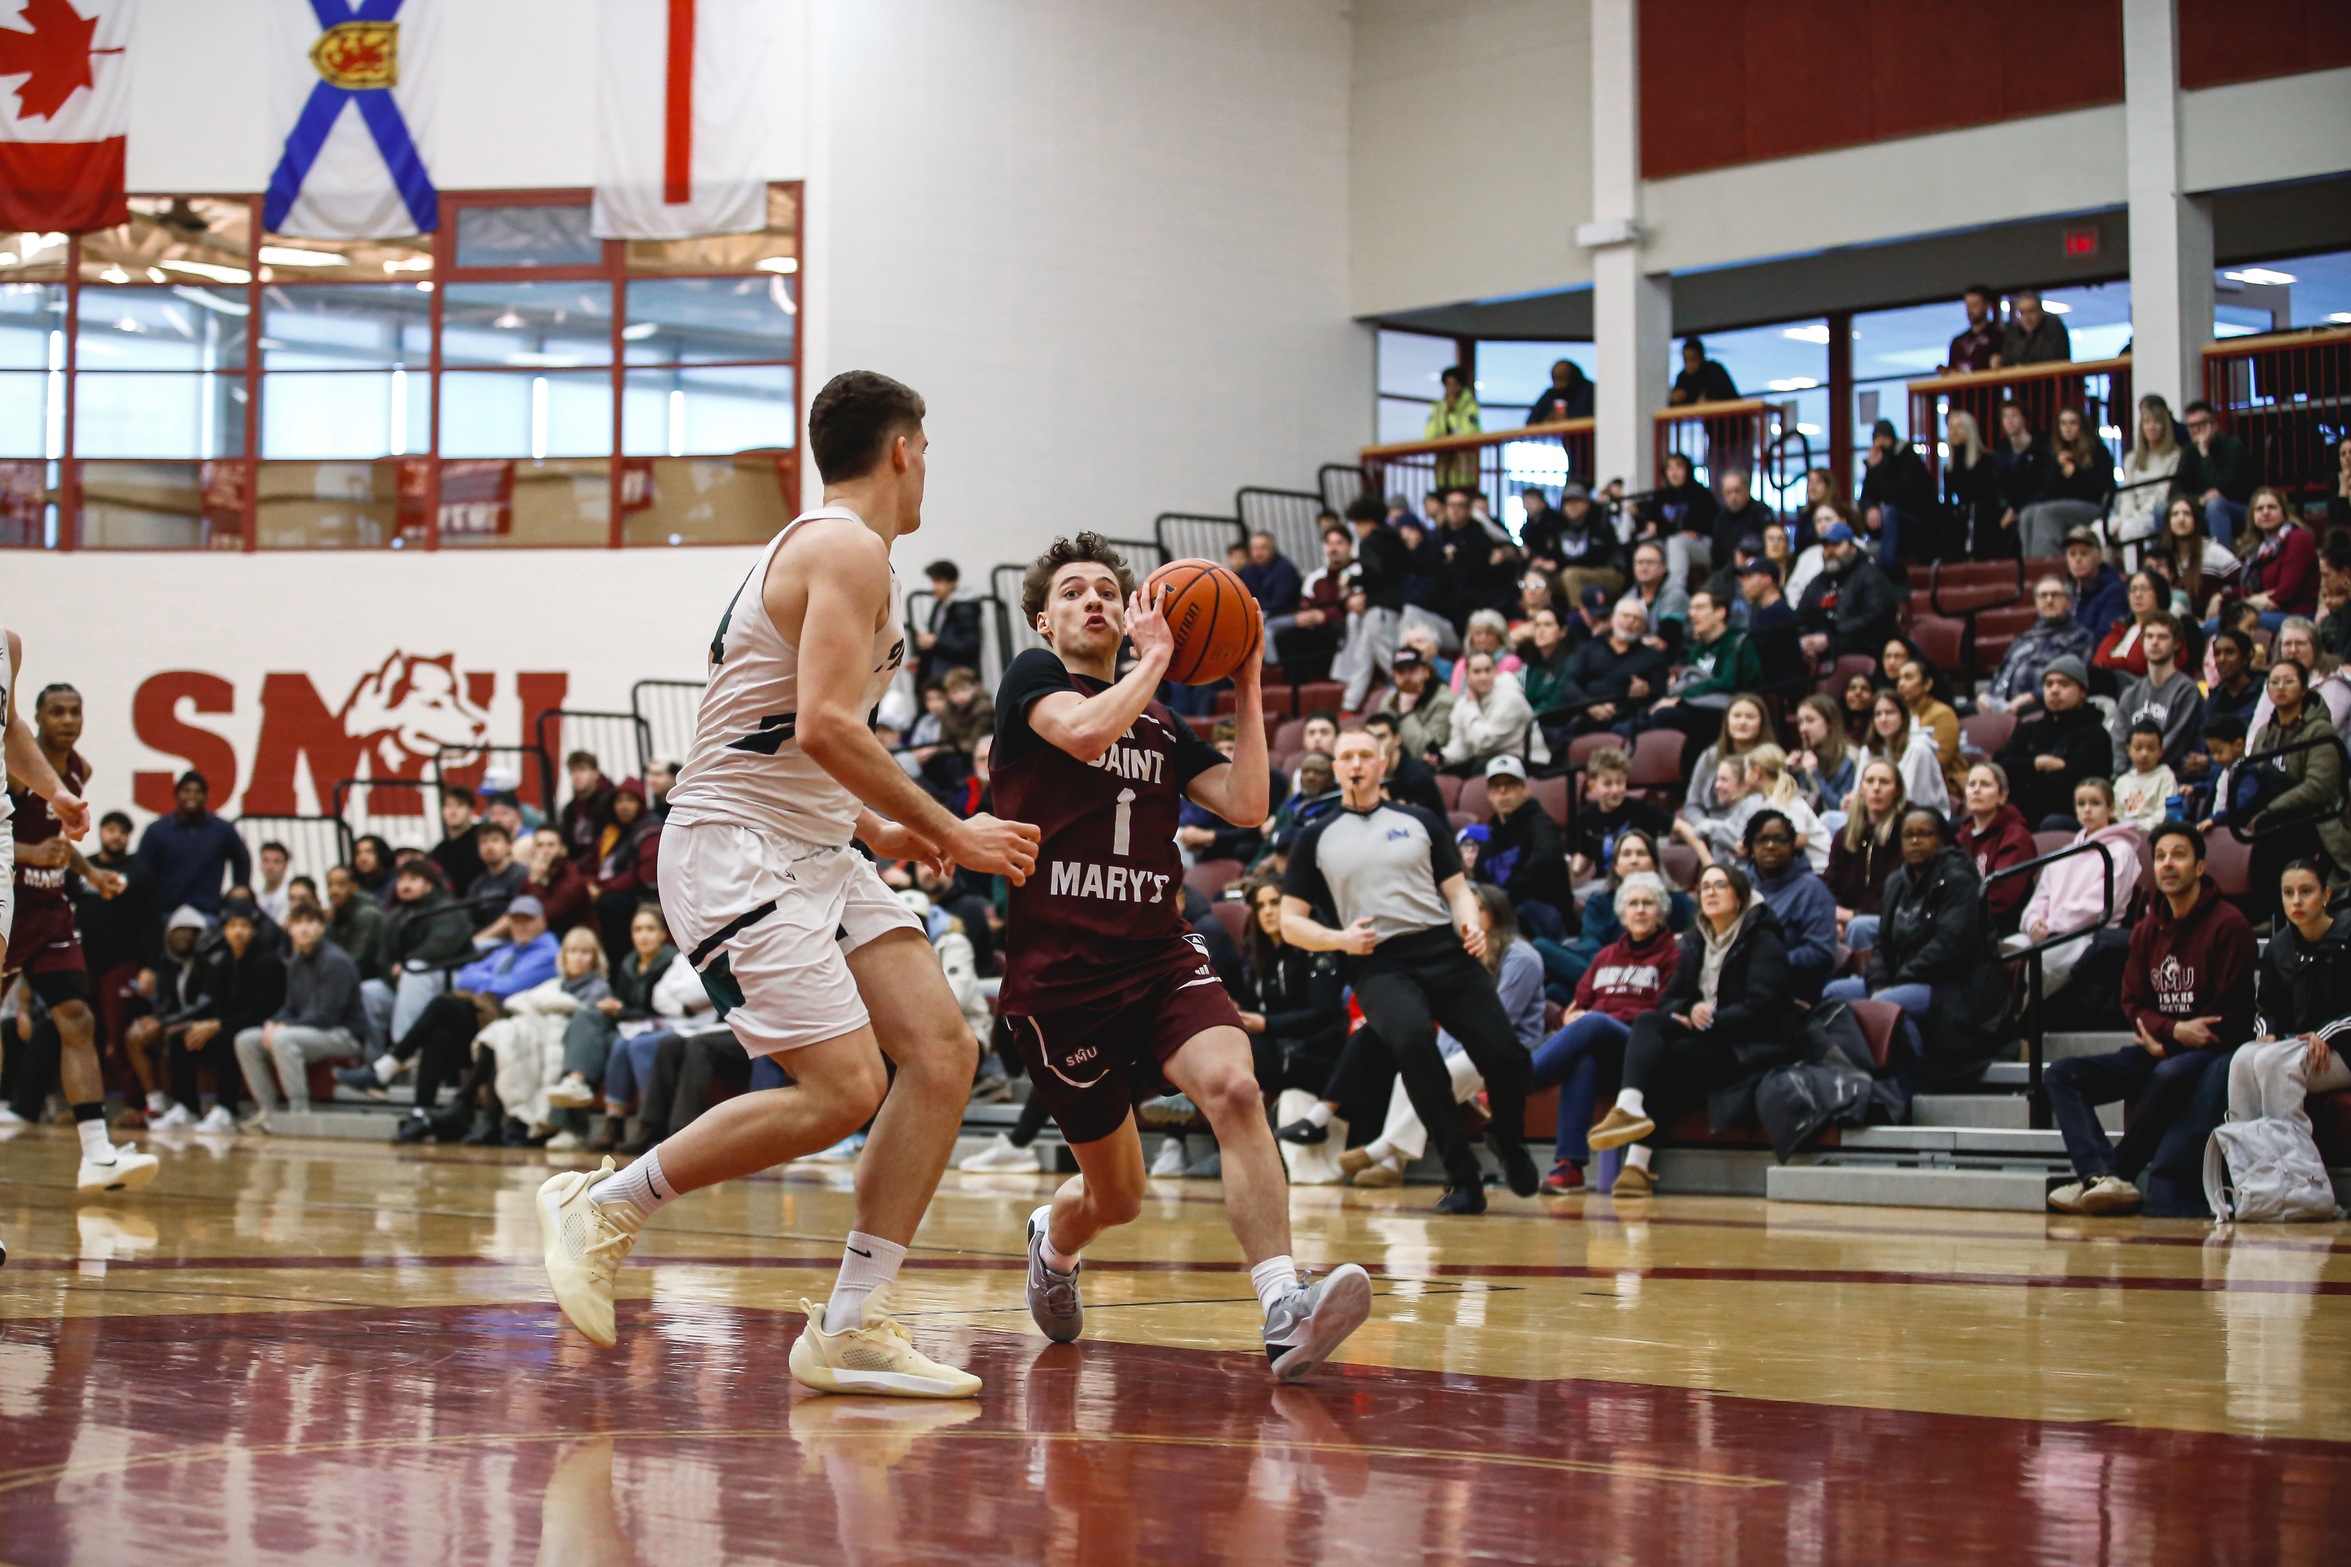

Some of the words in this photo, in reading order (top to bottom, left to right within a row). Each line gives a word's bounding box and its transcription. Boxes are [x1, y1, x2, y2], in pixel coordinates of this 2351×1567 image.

[132, 670, 568, 817] SMU
[1113, 787, 1136, 856] 1
[1050, 860, 1170, 904] MARY'S
[1066, 1046, 1098, 1067] SMU
